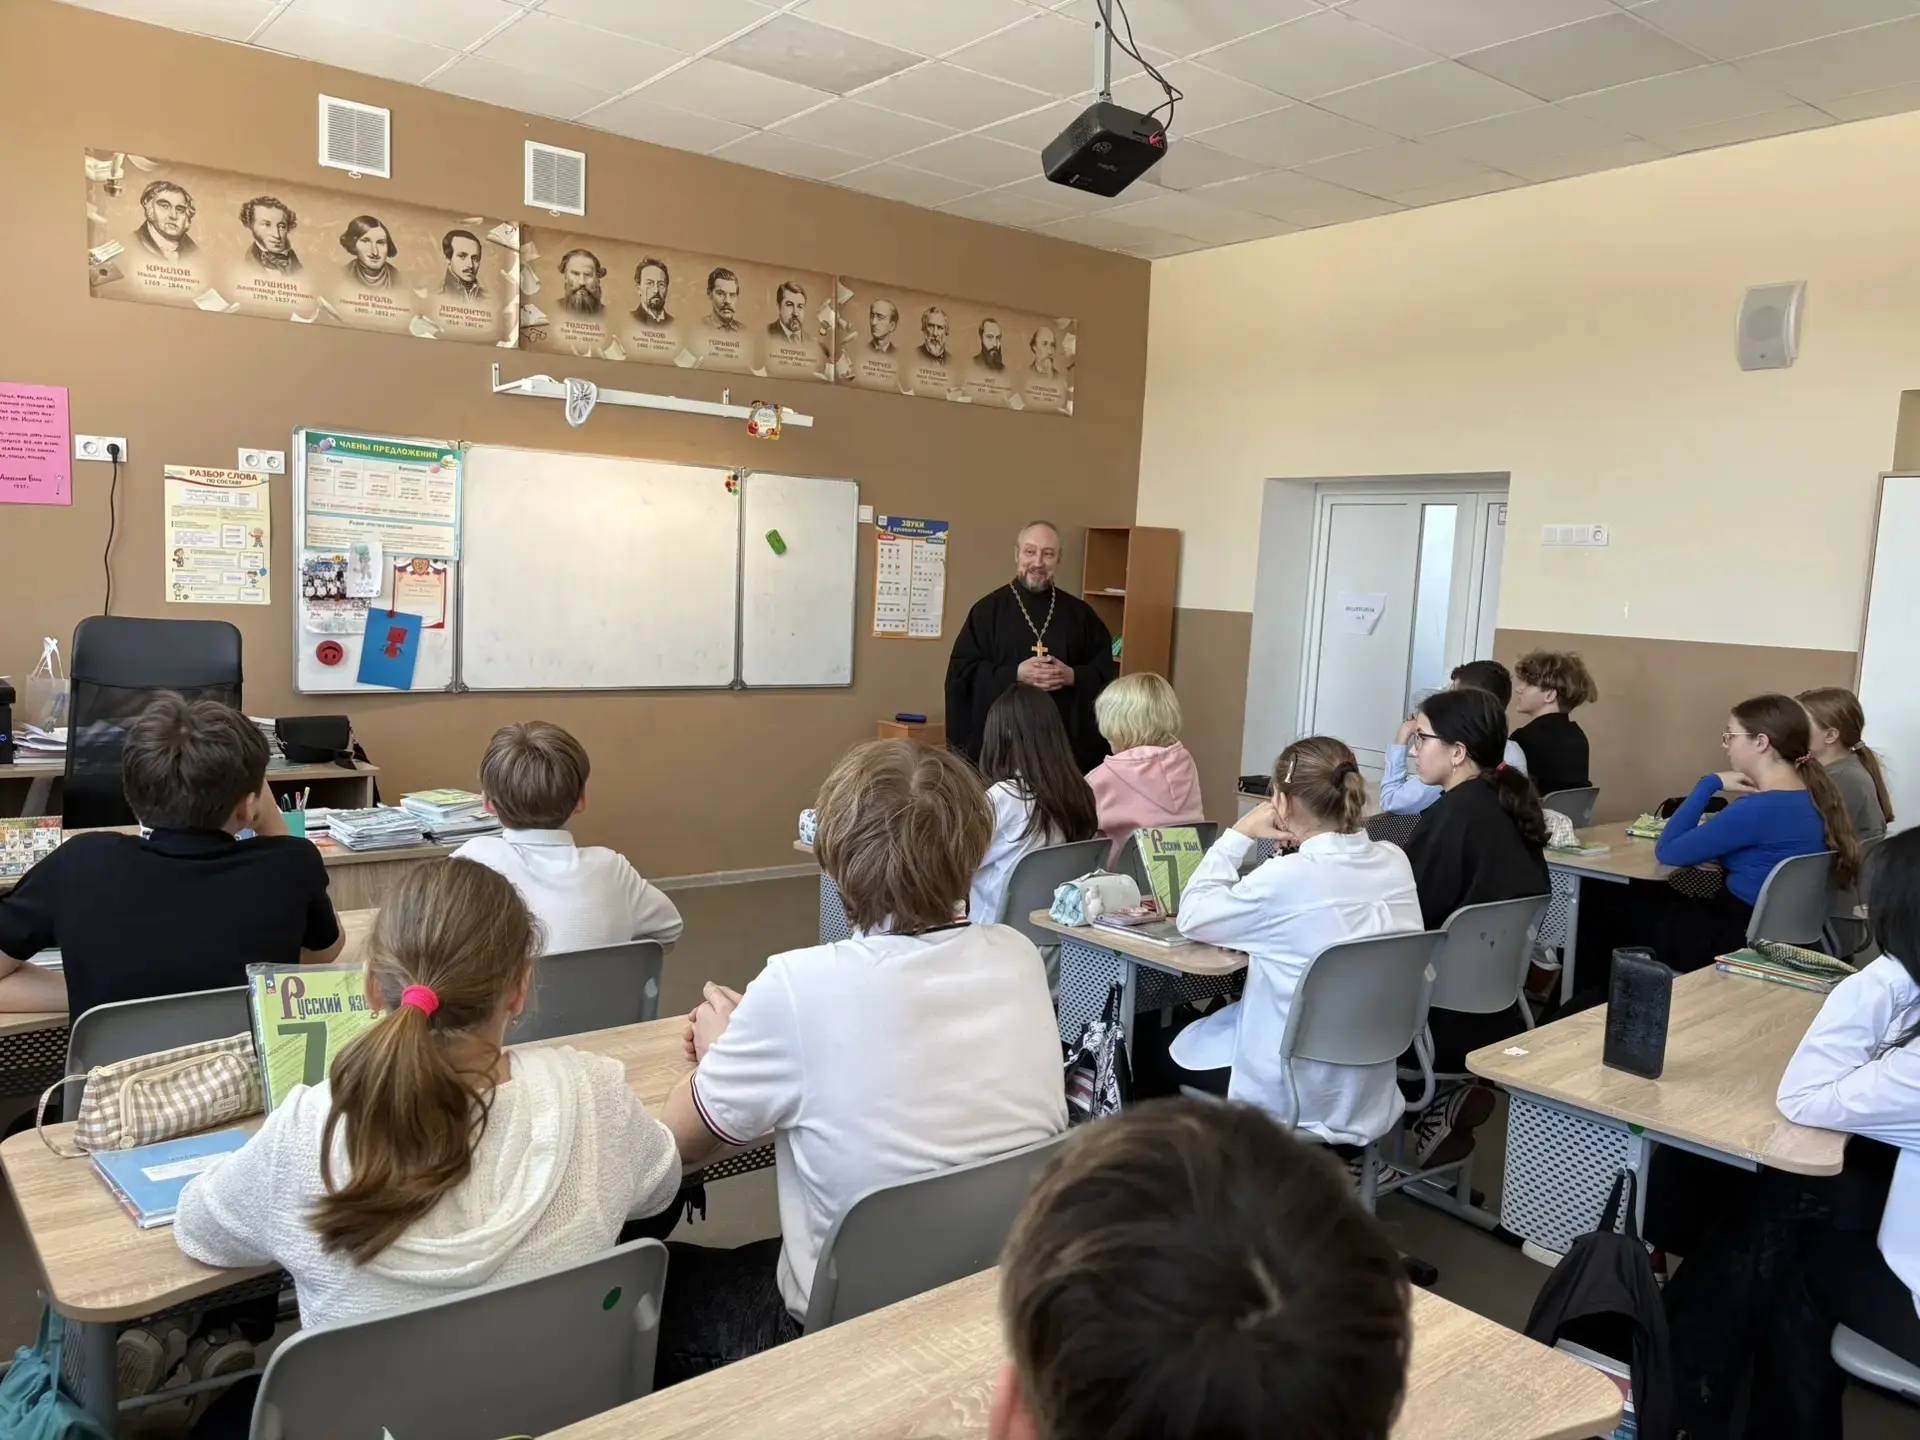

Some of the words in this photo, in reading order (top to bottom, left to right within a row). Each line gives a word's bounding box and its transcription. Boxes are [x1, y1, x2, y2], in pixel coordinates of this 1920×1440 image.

[146, 264, 191, 277] КРЫЛОВ
[144, 279, 160, 287] 1769
[254, 279, 297, 291] ПУШКИН
[358, 293, 393, 304] ГОГОЛЬ
[440, 304, 491, 317] ЛЕРМОНТОВ
[564, 321, 601, 331] ТОЛСТОЙ
[642, 330, 666, 339] ЧЕХОВ
[708, 339, 740, 348] ГОРЬКИЙ
[339, 440, 371, 452] ЧЛЕНЫ
[373, 444, 438, 459] ПРЕДЛОЖЕНИЯ
[189, 469, 225, 479] РАЗБОР
[227, 471, 257, 481] СЛОВА
[901, 519, 925, 528] ЗВУКИ
[1152, 855, 1182, 914] 7
[277, 1021, 327, 1087] 7
